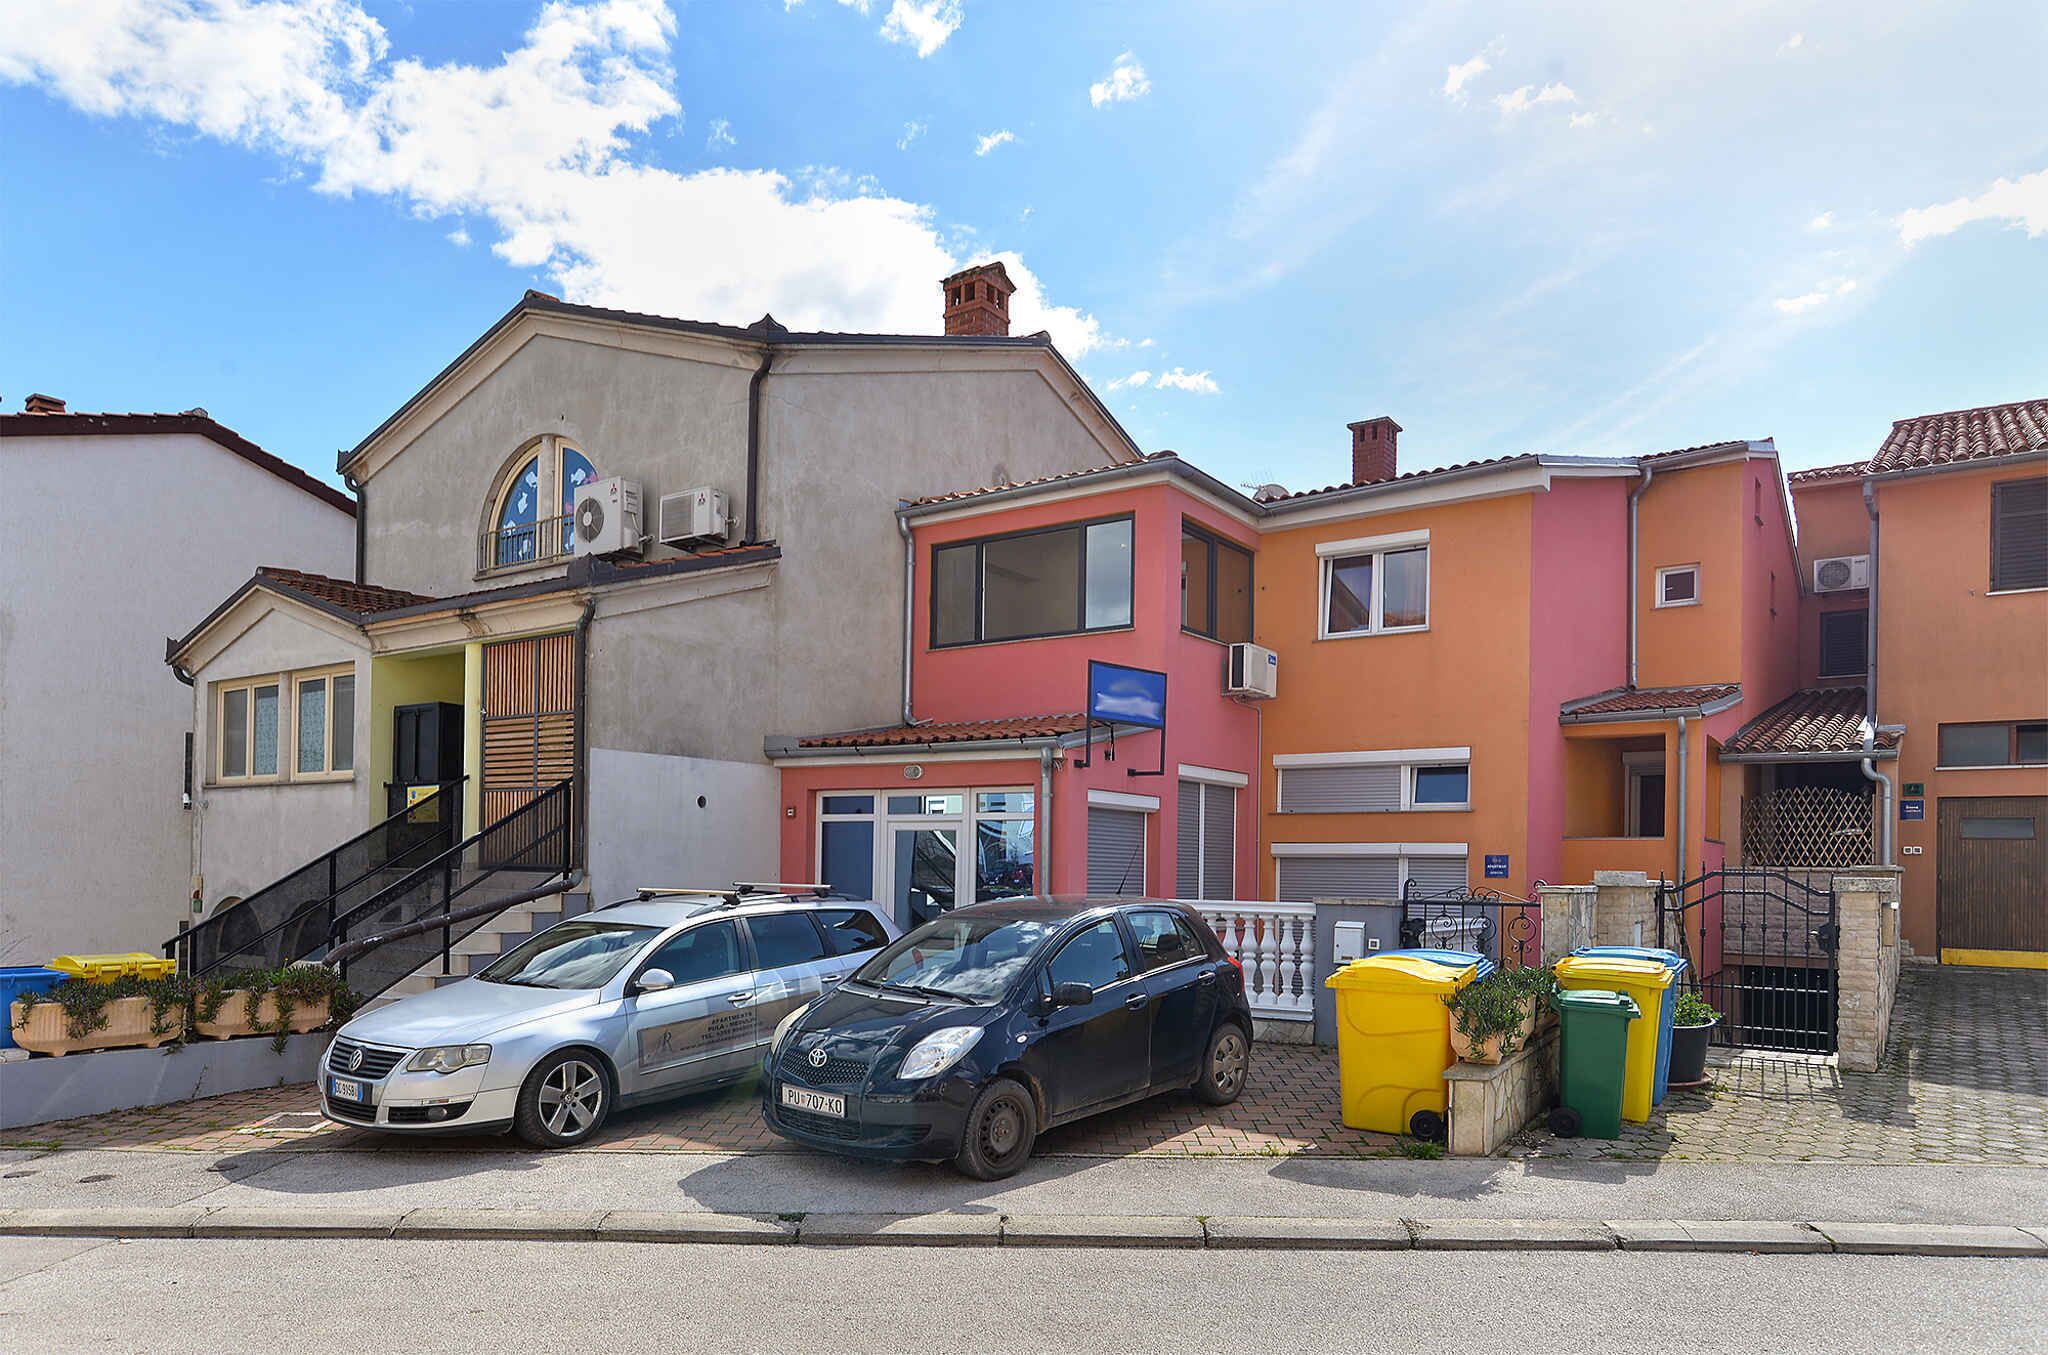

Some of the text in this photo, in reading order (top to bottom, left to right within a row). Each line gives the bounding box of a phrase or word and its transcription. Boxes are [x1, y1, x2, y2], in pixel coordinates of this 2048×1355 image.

[711, 1011, 753, 1025] APARTMENTS
[708, 1023, 725, 1032] PULA
[788, 1090, 842, 1114] PU 707-KO
